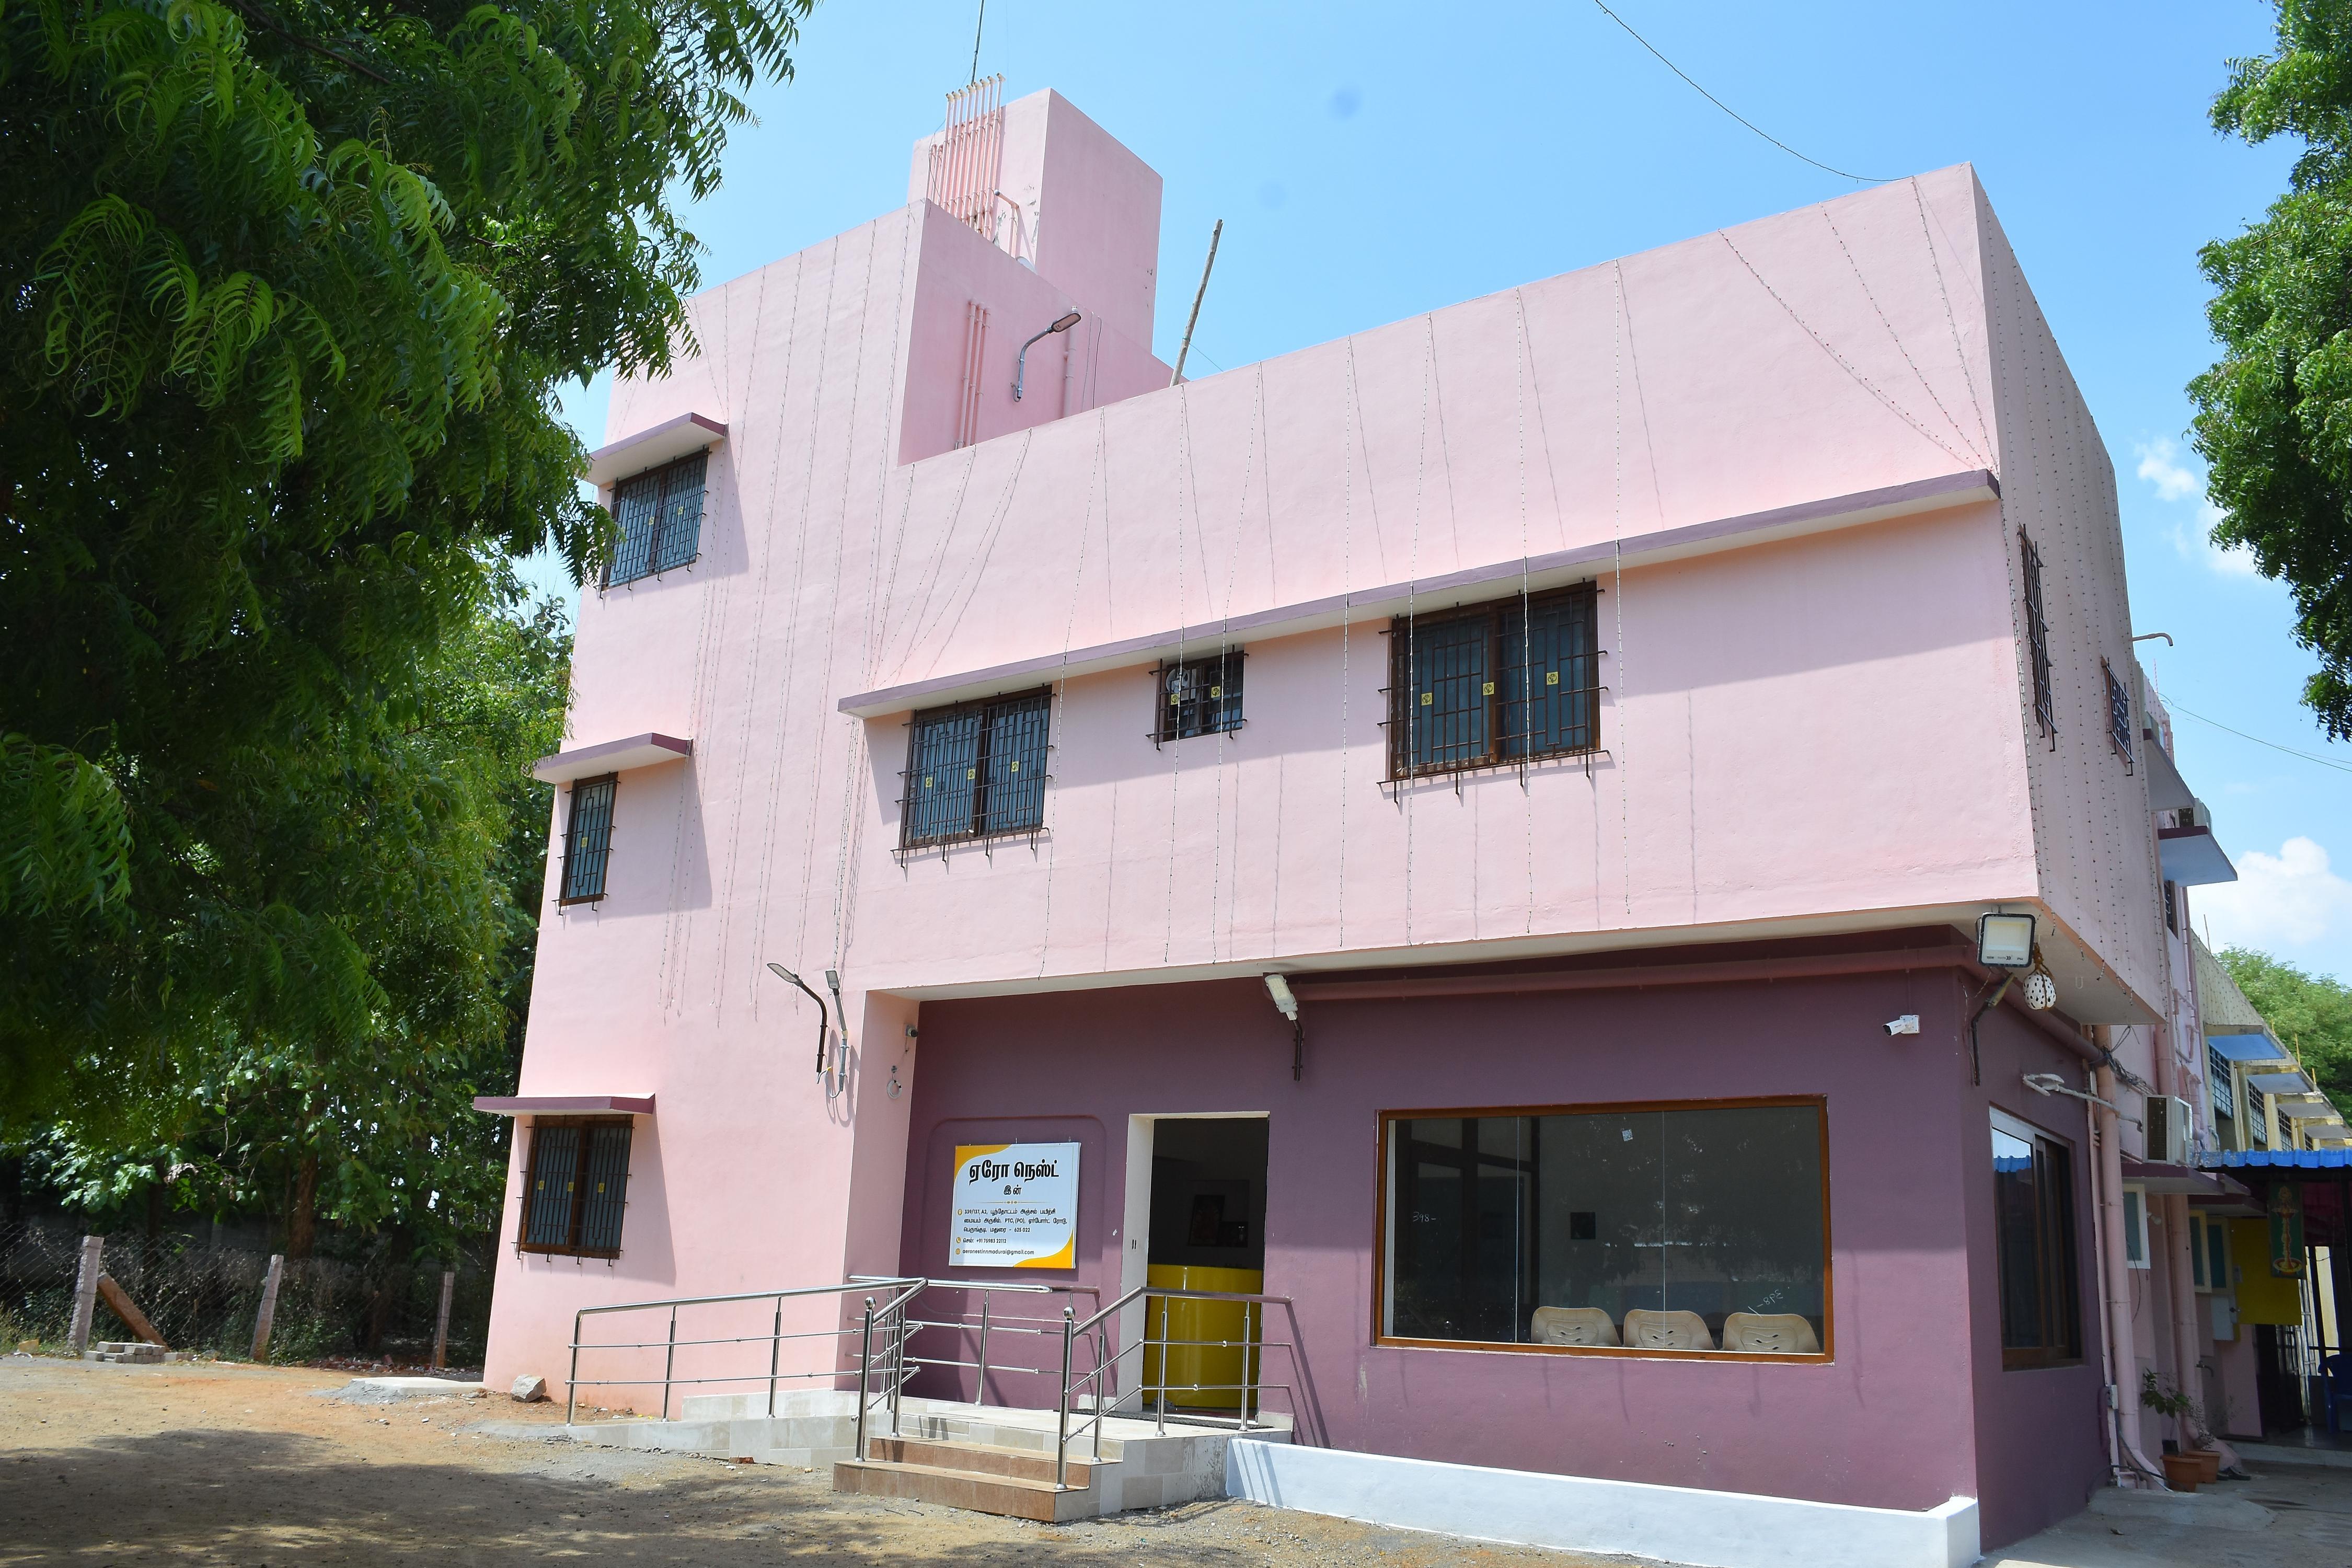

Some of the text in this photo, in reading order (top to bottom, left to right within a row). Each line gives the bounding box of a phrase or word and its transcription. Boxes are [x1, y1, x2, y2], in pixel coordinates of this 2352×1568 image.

[969, 1159, 1059, 1185] ஏரோ நெஸ்ட்
[1004, 1184, 1022, 1195] இன்
